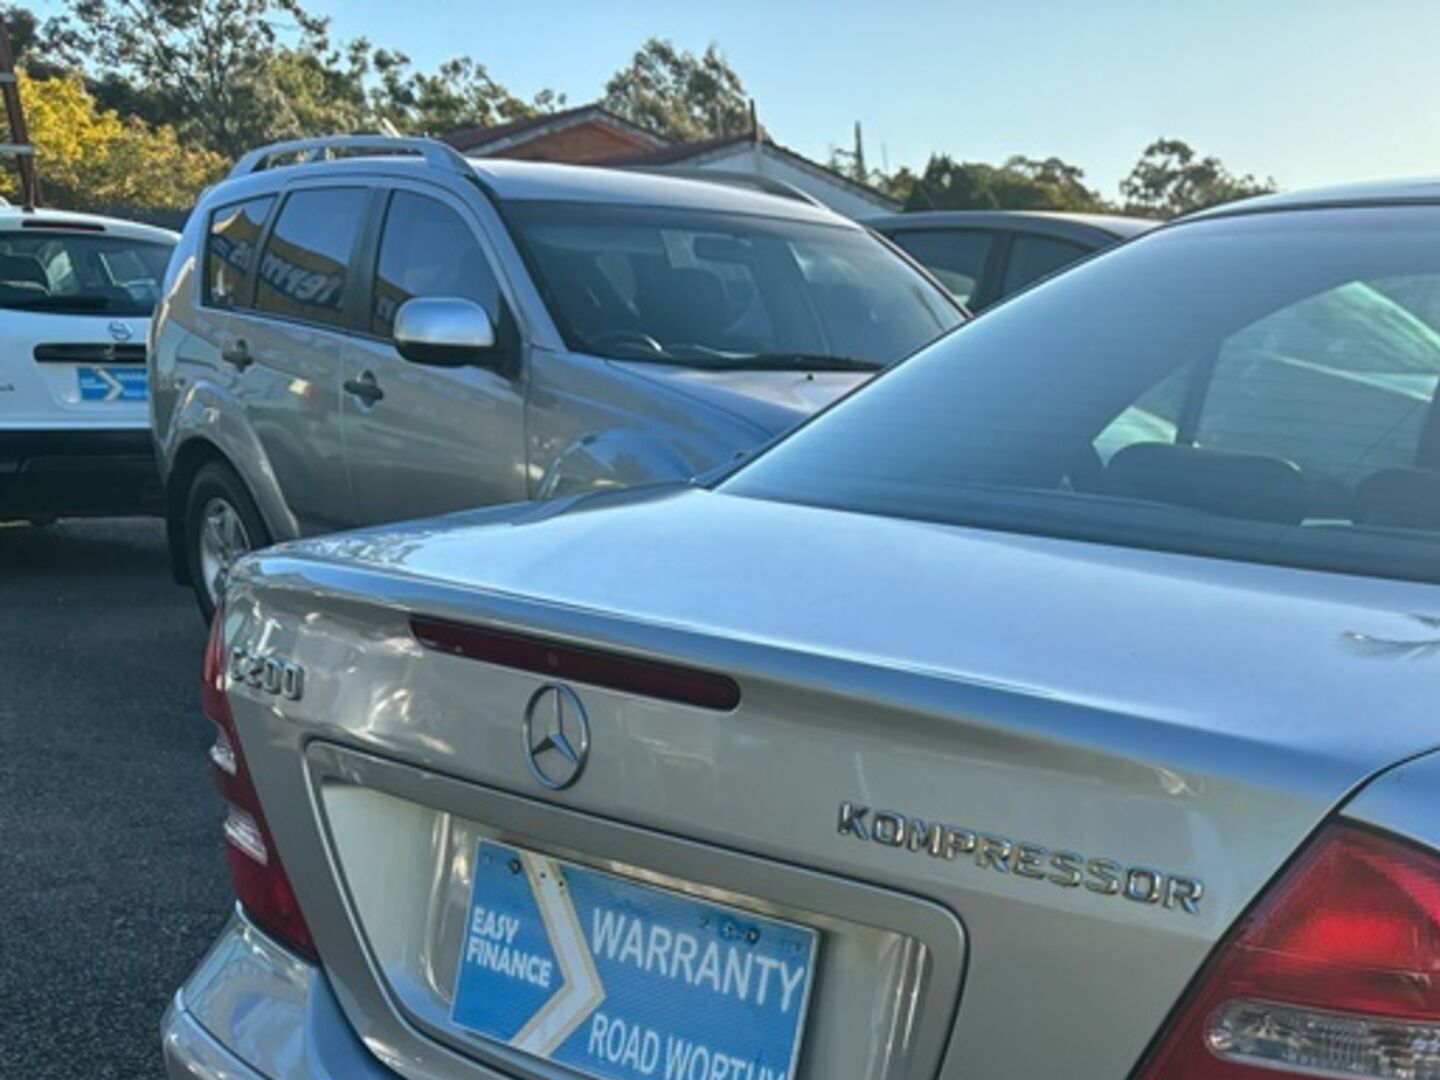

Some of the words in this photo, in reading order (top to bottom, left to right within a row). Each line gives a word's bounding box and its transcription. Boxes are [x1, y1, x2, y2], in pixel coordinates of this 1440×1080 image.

[837, 800, 1205, 914] KOMPRESSOR
[471, 905, 520, 945] EASY
[466, 934, 553, 989] FINANCE
[591, 906, 805, 1013] WARRANTY
[588, 1012, 660, 1076] ROAD
